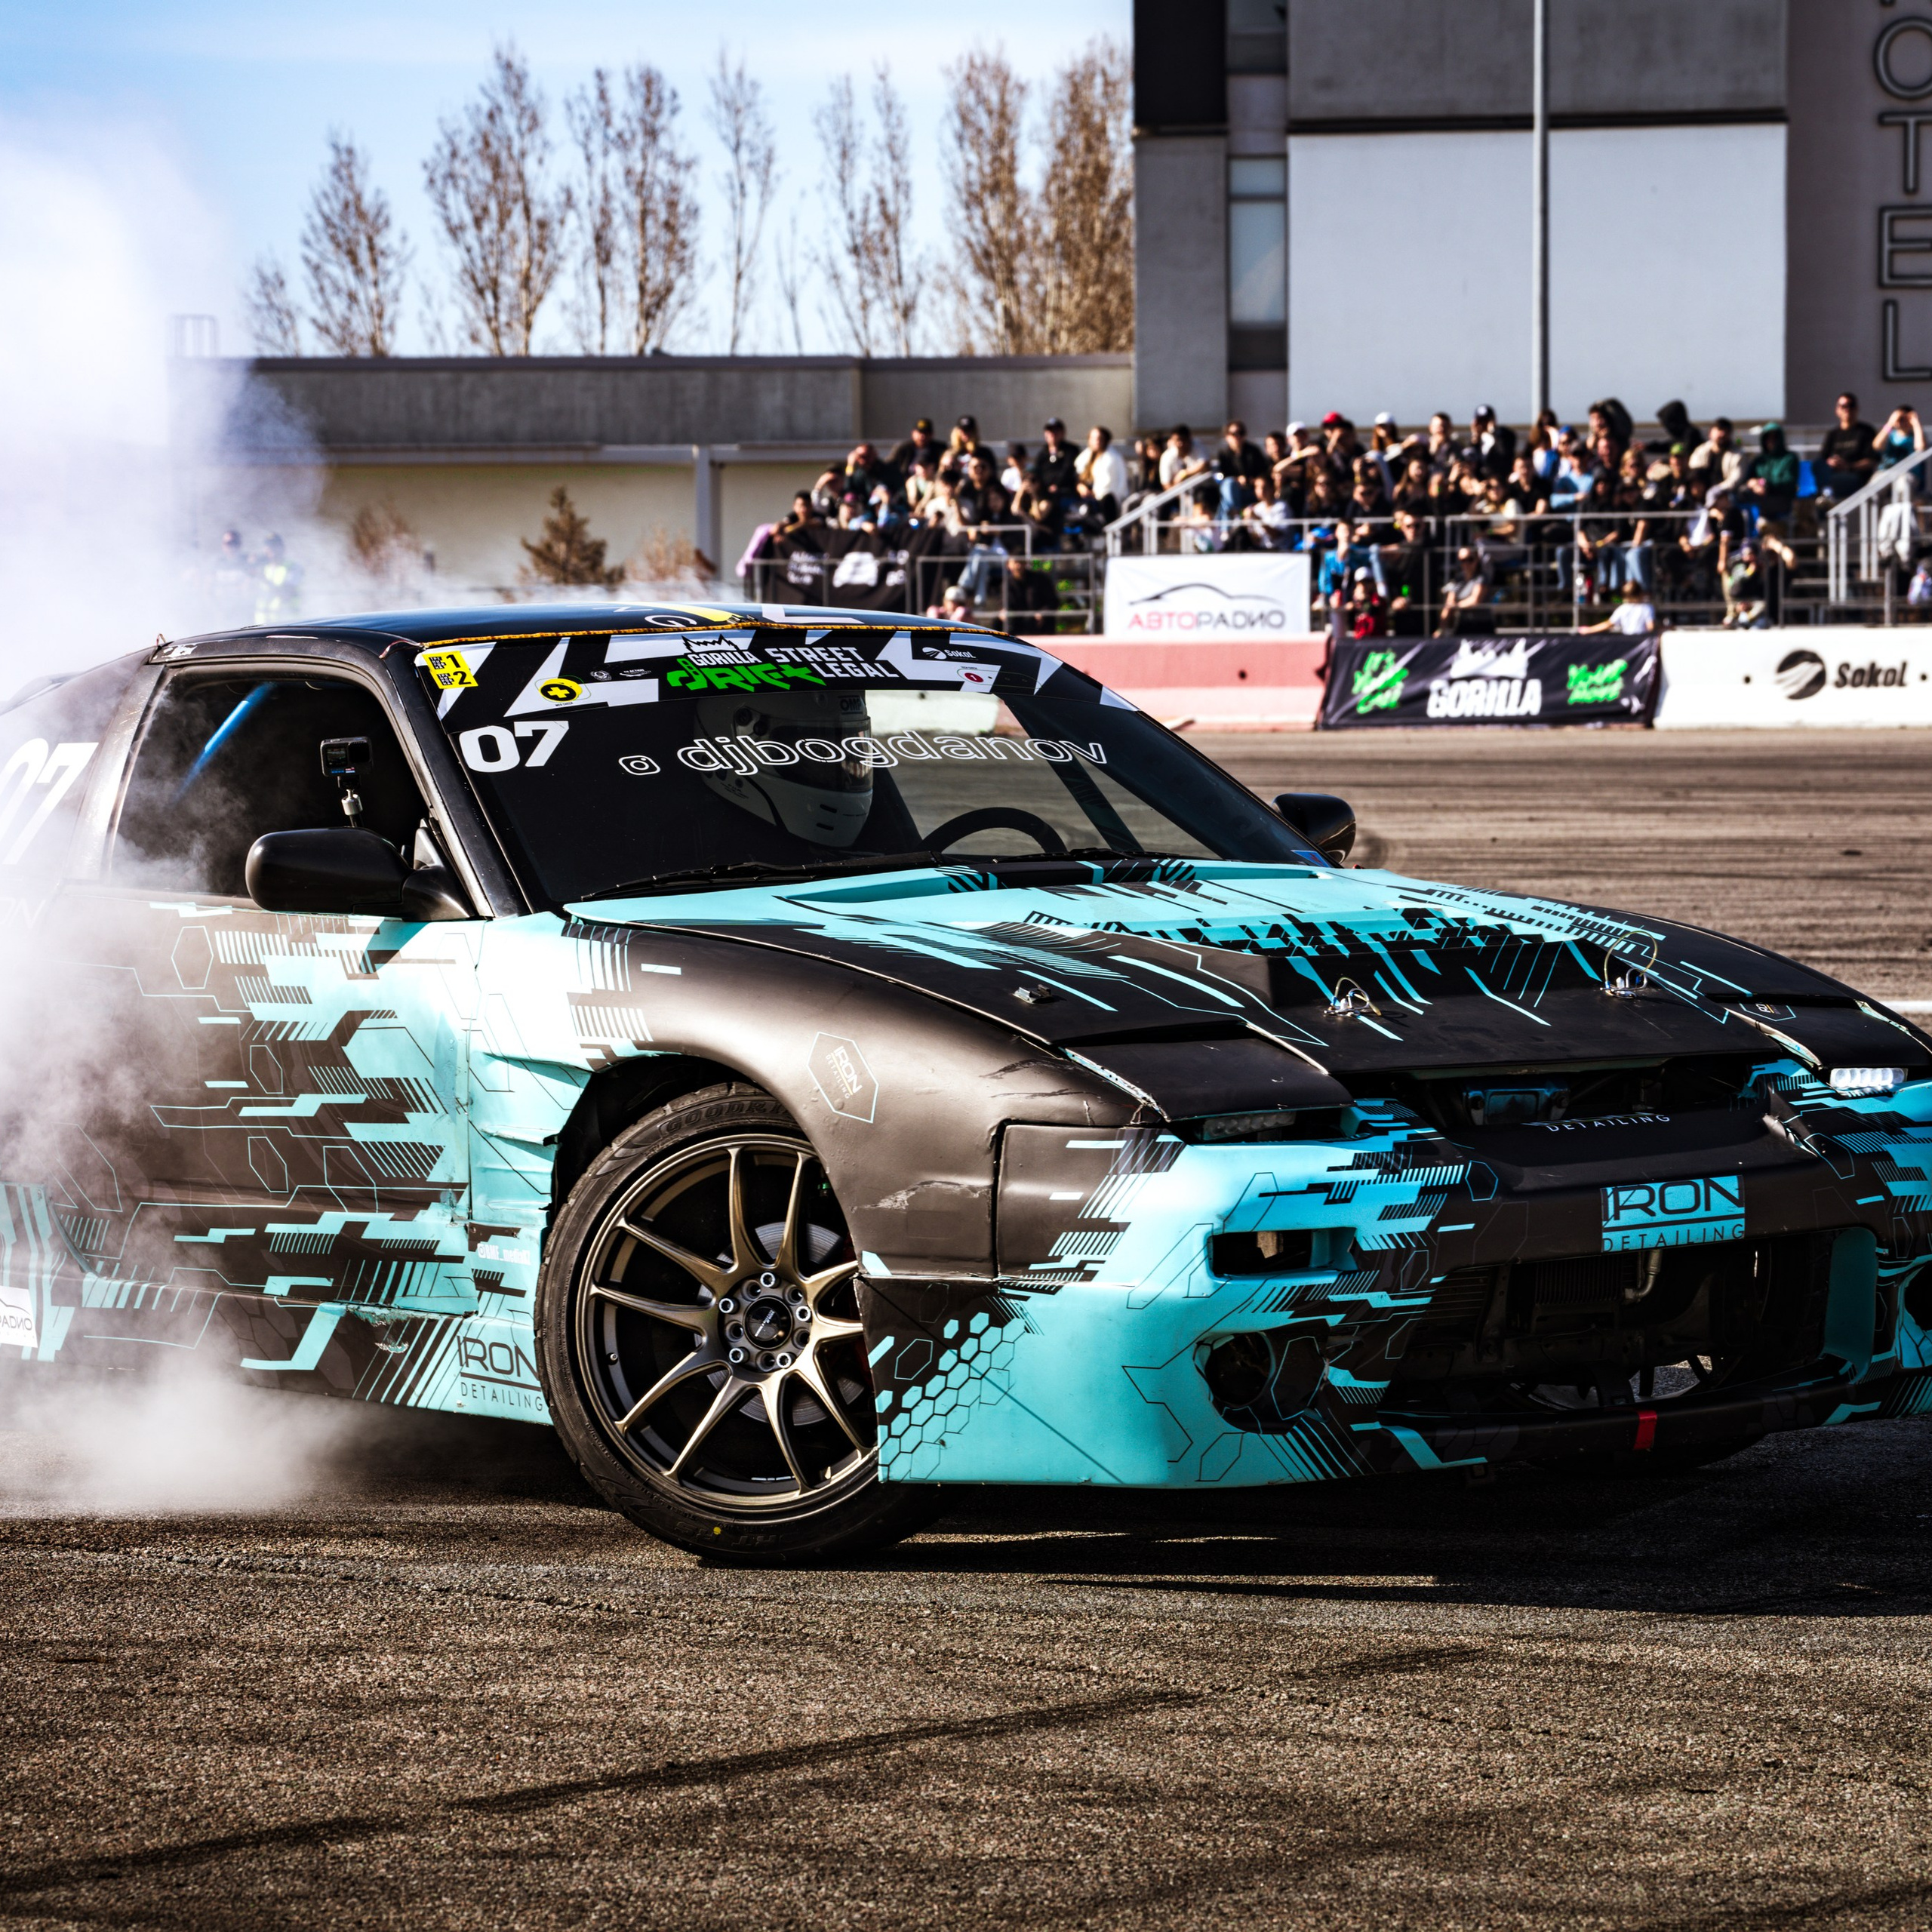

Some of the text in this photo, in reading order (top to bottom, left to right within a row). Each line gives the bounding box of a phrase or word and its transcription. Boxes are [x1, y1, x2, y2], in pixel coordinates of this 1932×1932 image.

[1874, 0, 1932, 382] OTEL
[446, 654, 460, 668] 1
[688, 651, 762, 666] GORILLA
[764, 647, 865, 663] STREET
[811, 663, 899, 678] LEGAL
[453, 671, 472, 685] 2
[1427, 679, 1542, 718] GORILLA
[459, 721, 569, 772] 07
[677, 731, 1107, 776] djbogdanov
[0, 738, 99, 866] 07
[826, 1054, 851, 1099] DETAILING
[833, 1046, 863, 1093] IRON
[665, 1100, 792, 1134] GOODRI
[1546, 1115, 1670, 1132] DETAILING
[1601, 1175, 1745, 1221] IRON
[1602, 1223, 1744, 1253] DETAILING
[457, 1335, 540, 1381] IRON
[461, 1382, 543, 1411] DETAILING
